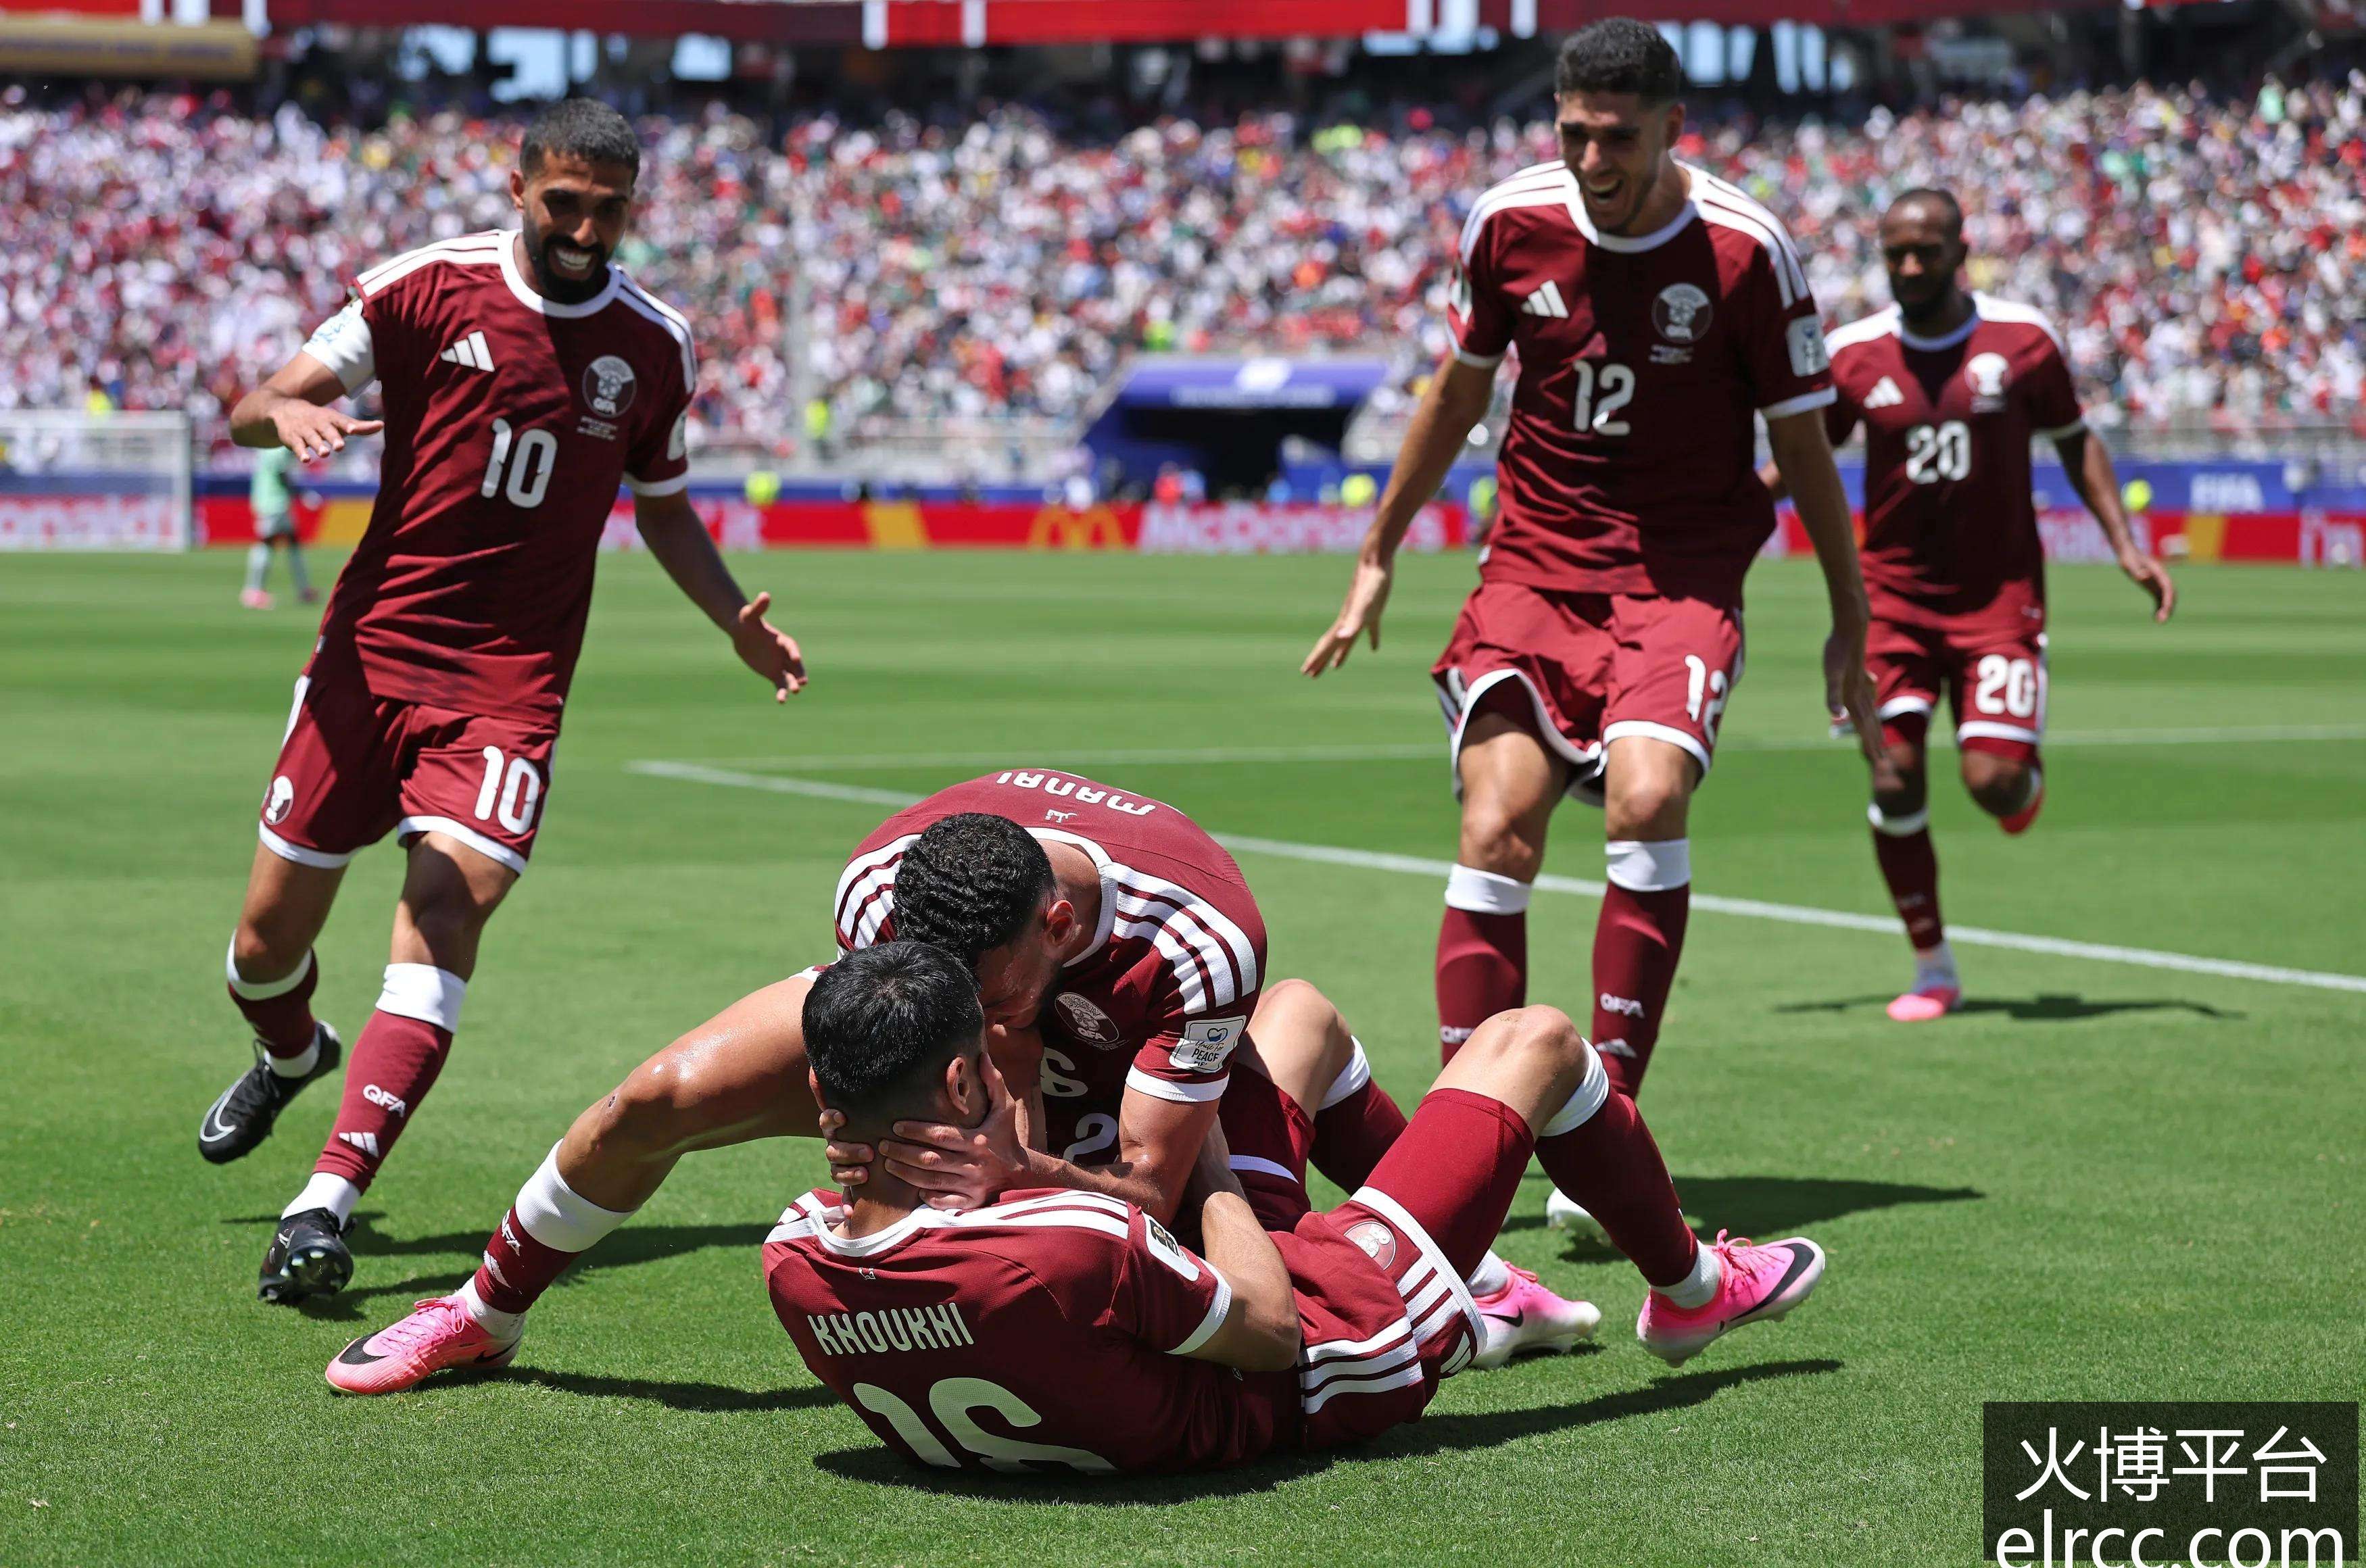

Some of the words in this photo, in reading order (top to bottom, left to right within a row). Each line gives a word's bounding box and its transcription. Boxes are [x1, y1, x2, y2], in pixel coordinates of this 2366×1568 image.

[1573, 360, 1635, 436] 12
[481, 418, 558, 508] 10
[1906, 420, 1971, 485] 20
[1685, 654, 1729, 745] 12
[1975, 653, 2036, 718] 20
[475, 745, 540, 835] 10
[996, 771, 1156, 816] MANAI
[1078, 1027, 1107, 1042] QFA
[362, 1083, 406, 1118] QFA
[807, 1302, 974, 1356] KHOUKHI
[853, 1377, 1119, 1475] 16
